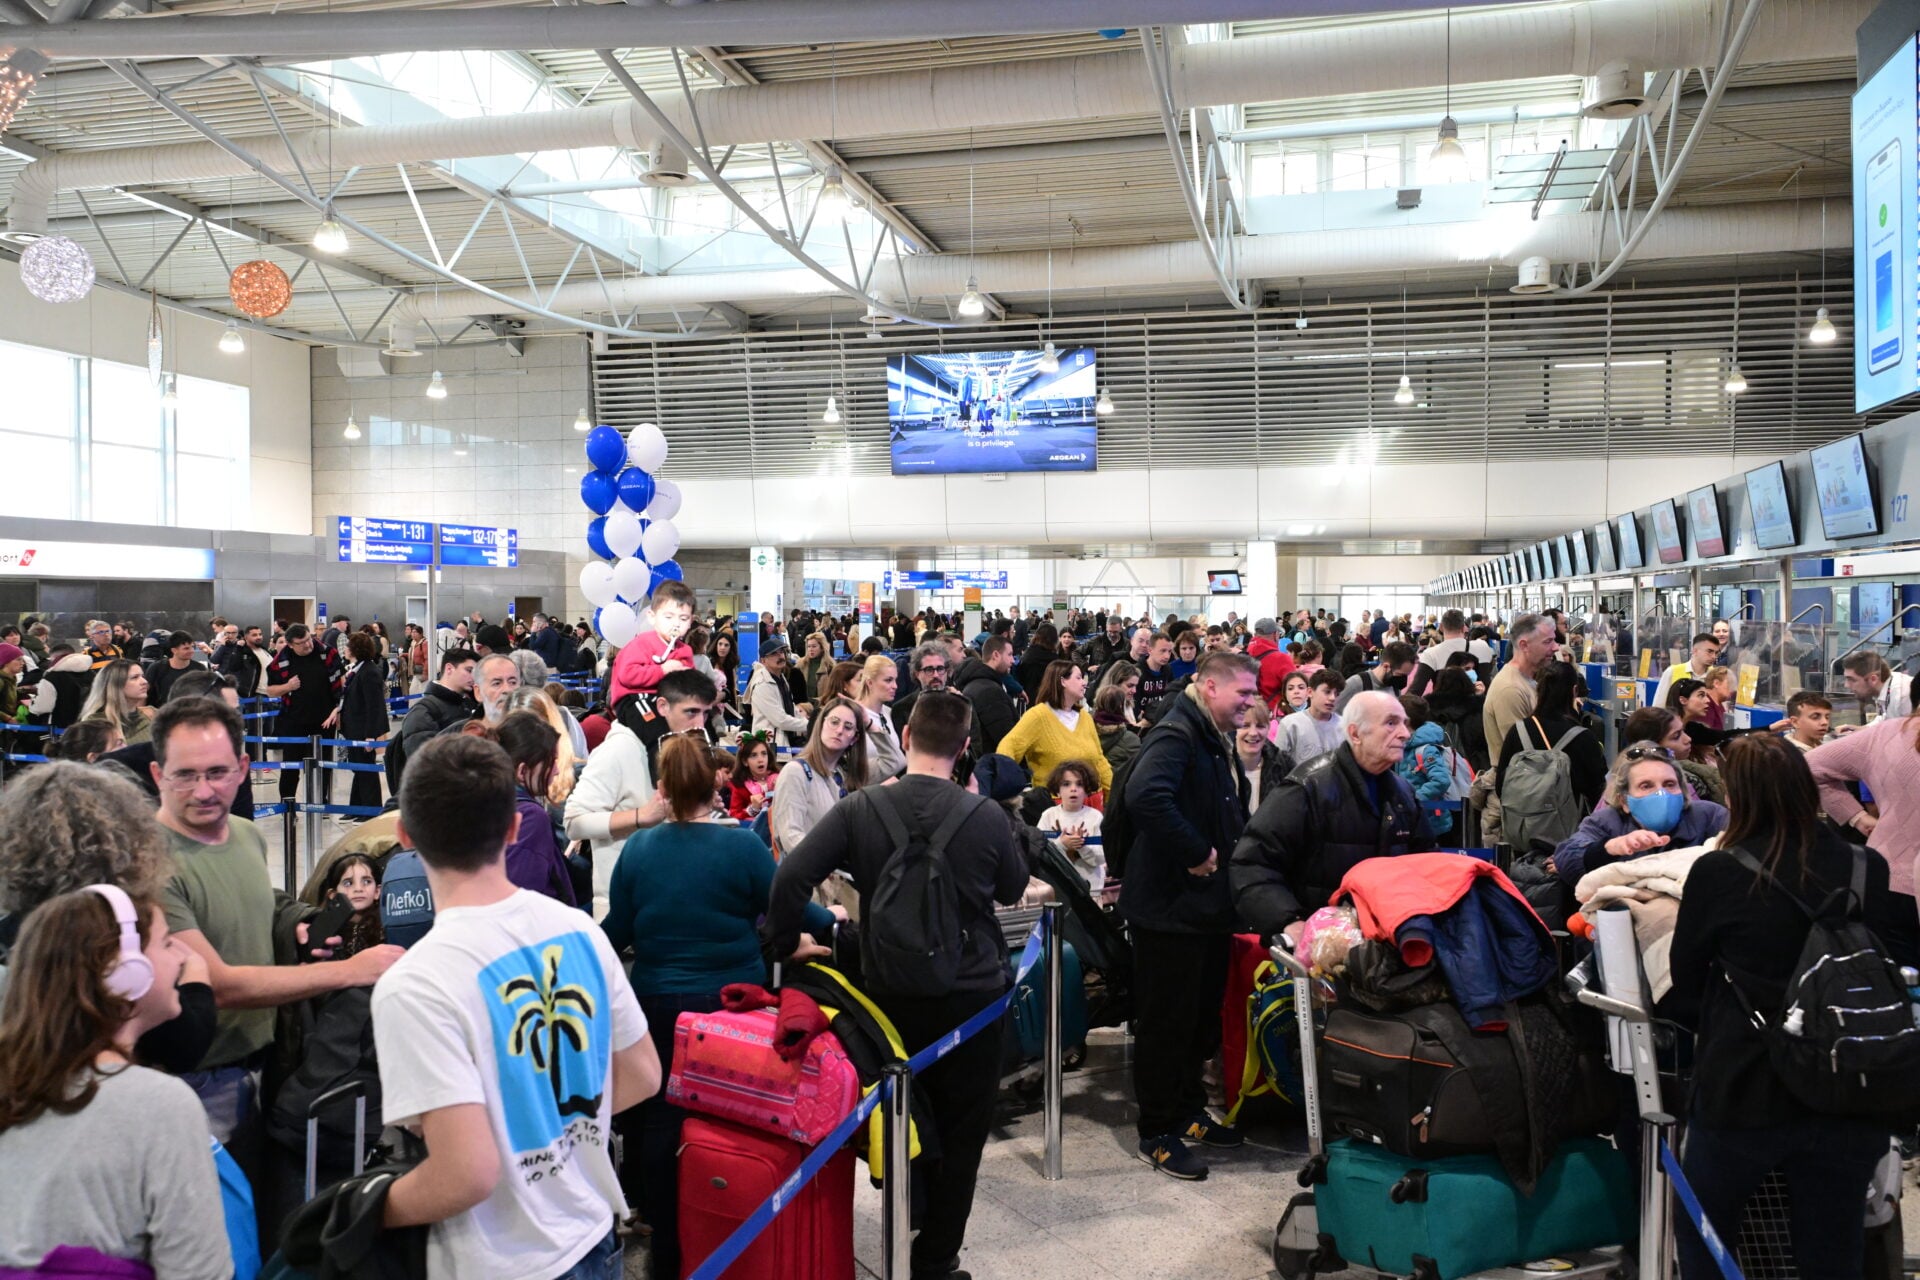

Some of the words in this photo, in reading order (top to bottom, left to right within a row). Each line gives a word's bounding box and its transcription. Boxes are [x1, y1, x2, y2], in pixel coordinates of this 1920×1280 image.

[952, 419, 986, 428] AEGEAN
[986, 429, 1003, 437] with
[967, 439, 974, 447] is
[982, 438, 1016, 449] privilege.
[1048, 454, 1080, 462] AEGEAN
[1890, 493, 1909, 524] 127
[402, 523, 426, 540] 1-131
